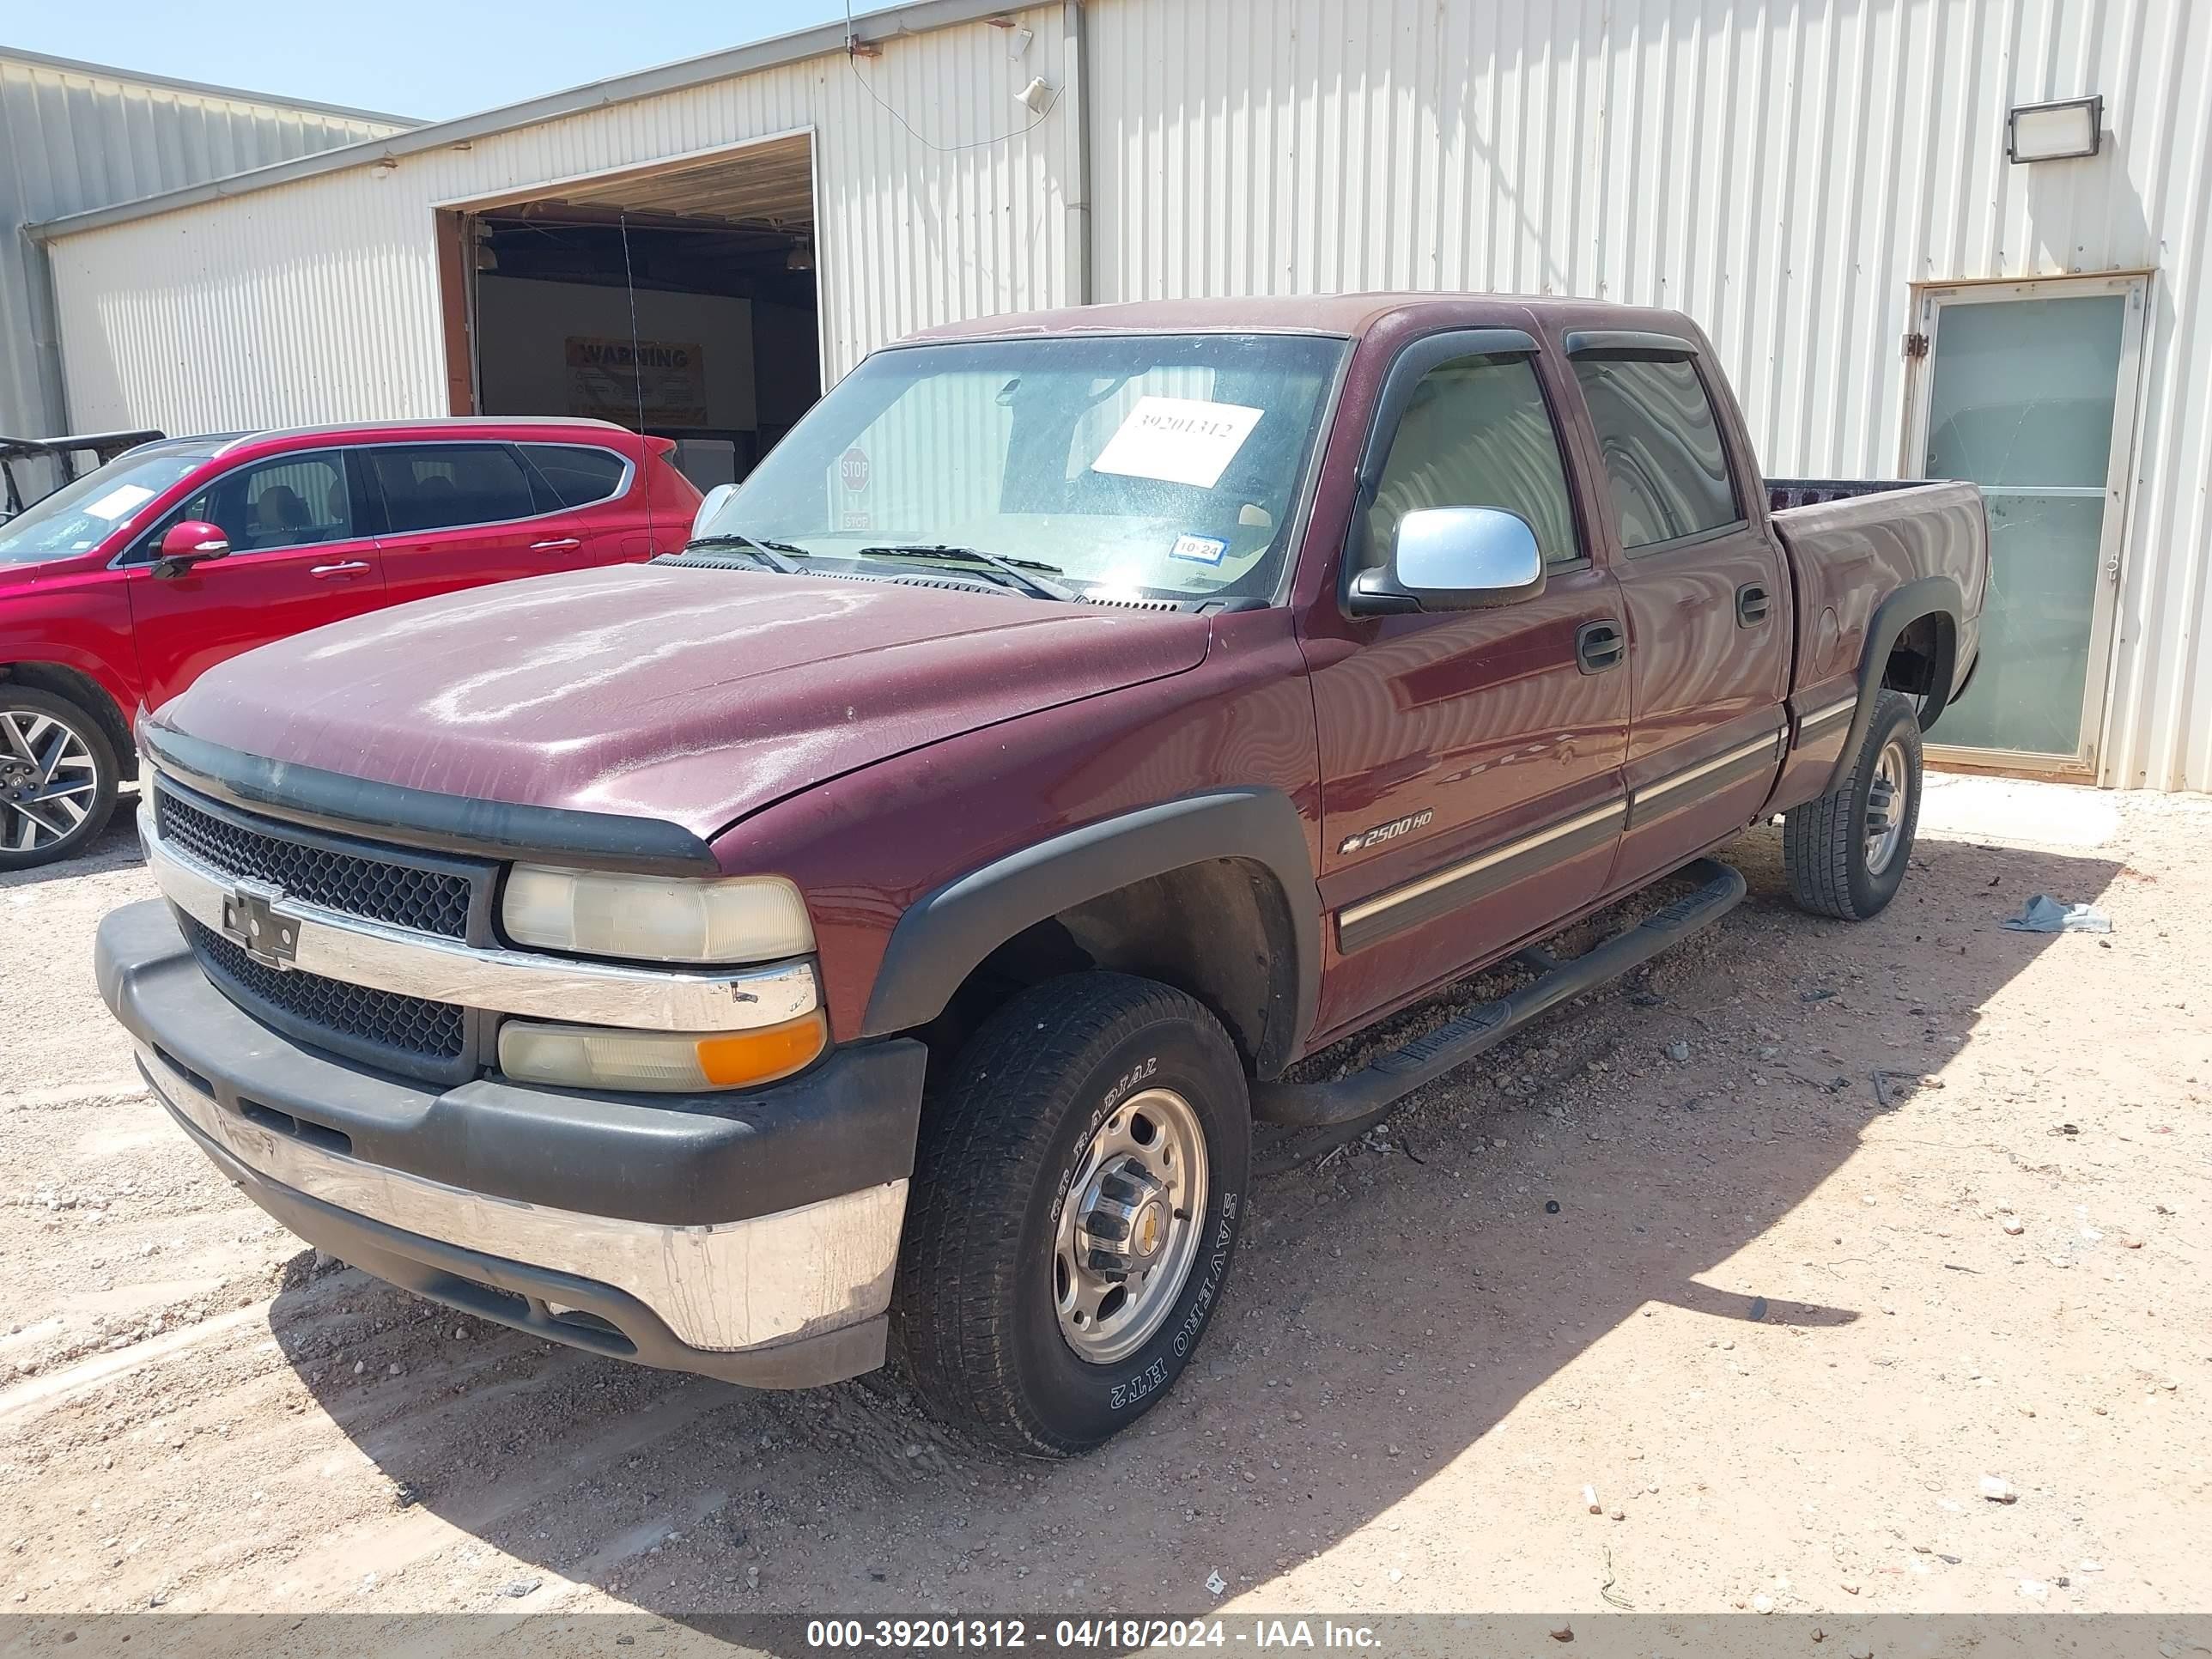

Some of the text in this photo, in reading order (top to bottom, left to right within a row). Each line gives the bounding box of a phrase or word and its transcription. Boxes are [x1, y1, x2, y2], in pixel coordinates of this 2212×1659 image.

[580, 343, 688, 368] WARNING
[1139, 414, 1234, 439] 39201312
[842, 460, 868, 477] STOP
[844, 516, 868, 528] STOP
[1364, 811, 1433, 848] 2500 HD
[1073, 1057, 1158, 1161] RADIAL
[1110, 1193, 1237, 1410] SAVERO HT2
